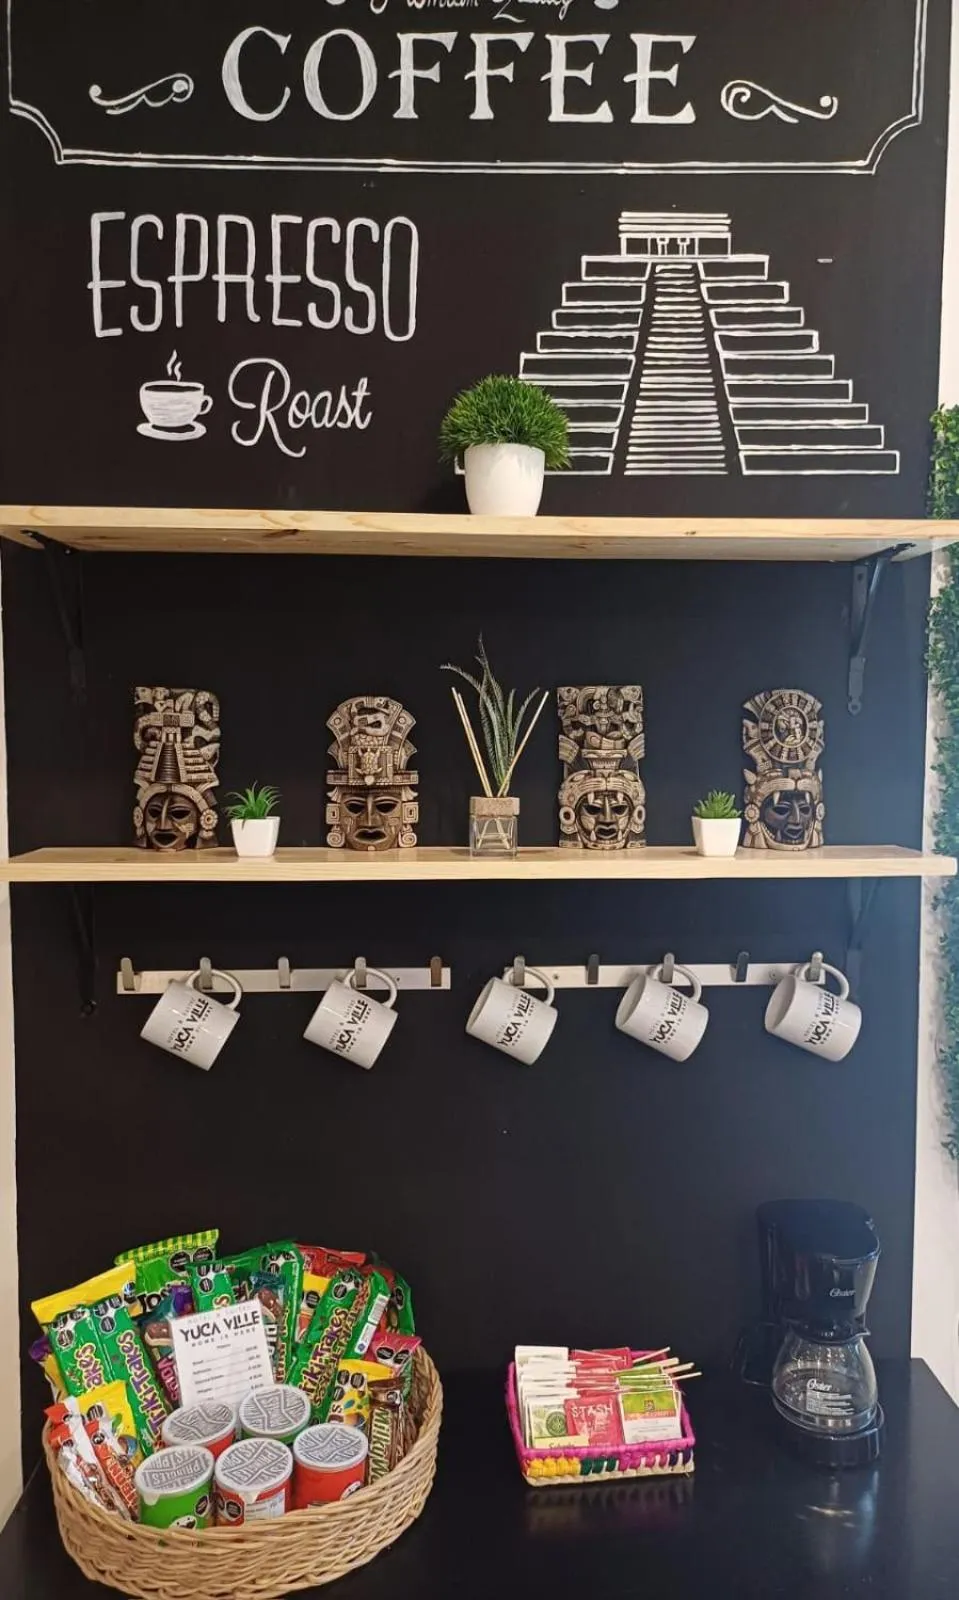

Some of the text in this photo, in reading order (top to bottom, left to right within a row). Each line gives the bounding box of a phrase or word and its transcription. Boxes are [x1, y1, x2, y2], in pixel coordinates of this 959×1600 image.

[221, 26, 697, 124] COFFEE
[87, 211, 419, 341] ESPRESSO
[228, 358, 373, 458] Roast
[496, 1022, 522, 1046] YUCA
[804, 1020, 830, 1045] YUCA
[179, 1322, 221, 1342] YUCA
[223, 1310, 260, 1330] VILLE
[571, 1400, 614, 1418] STASH
